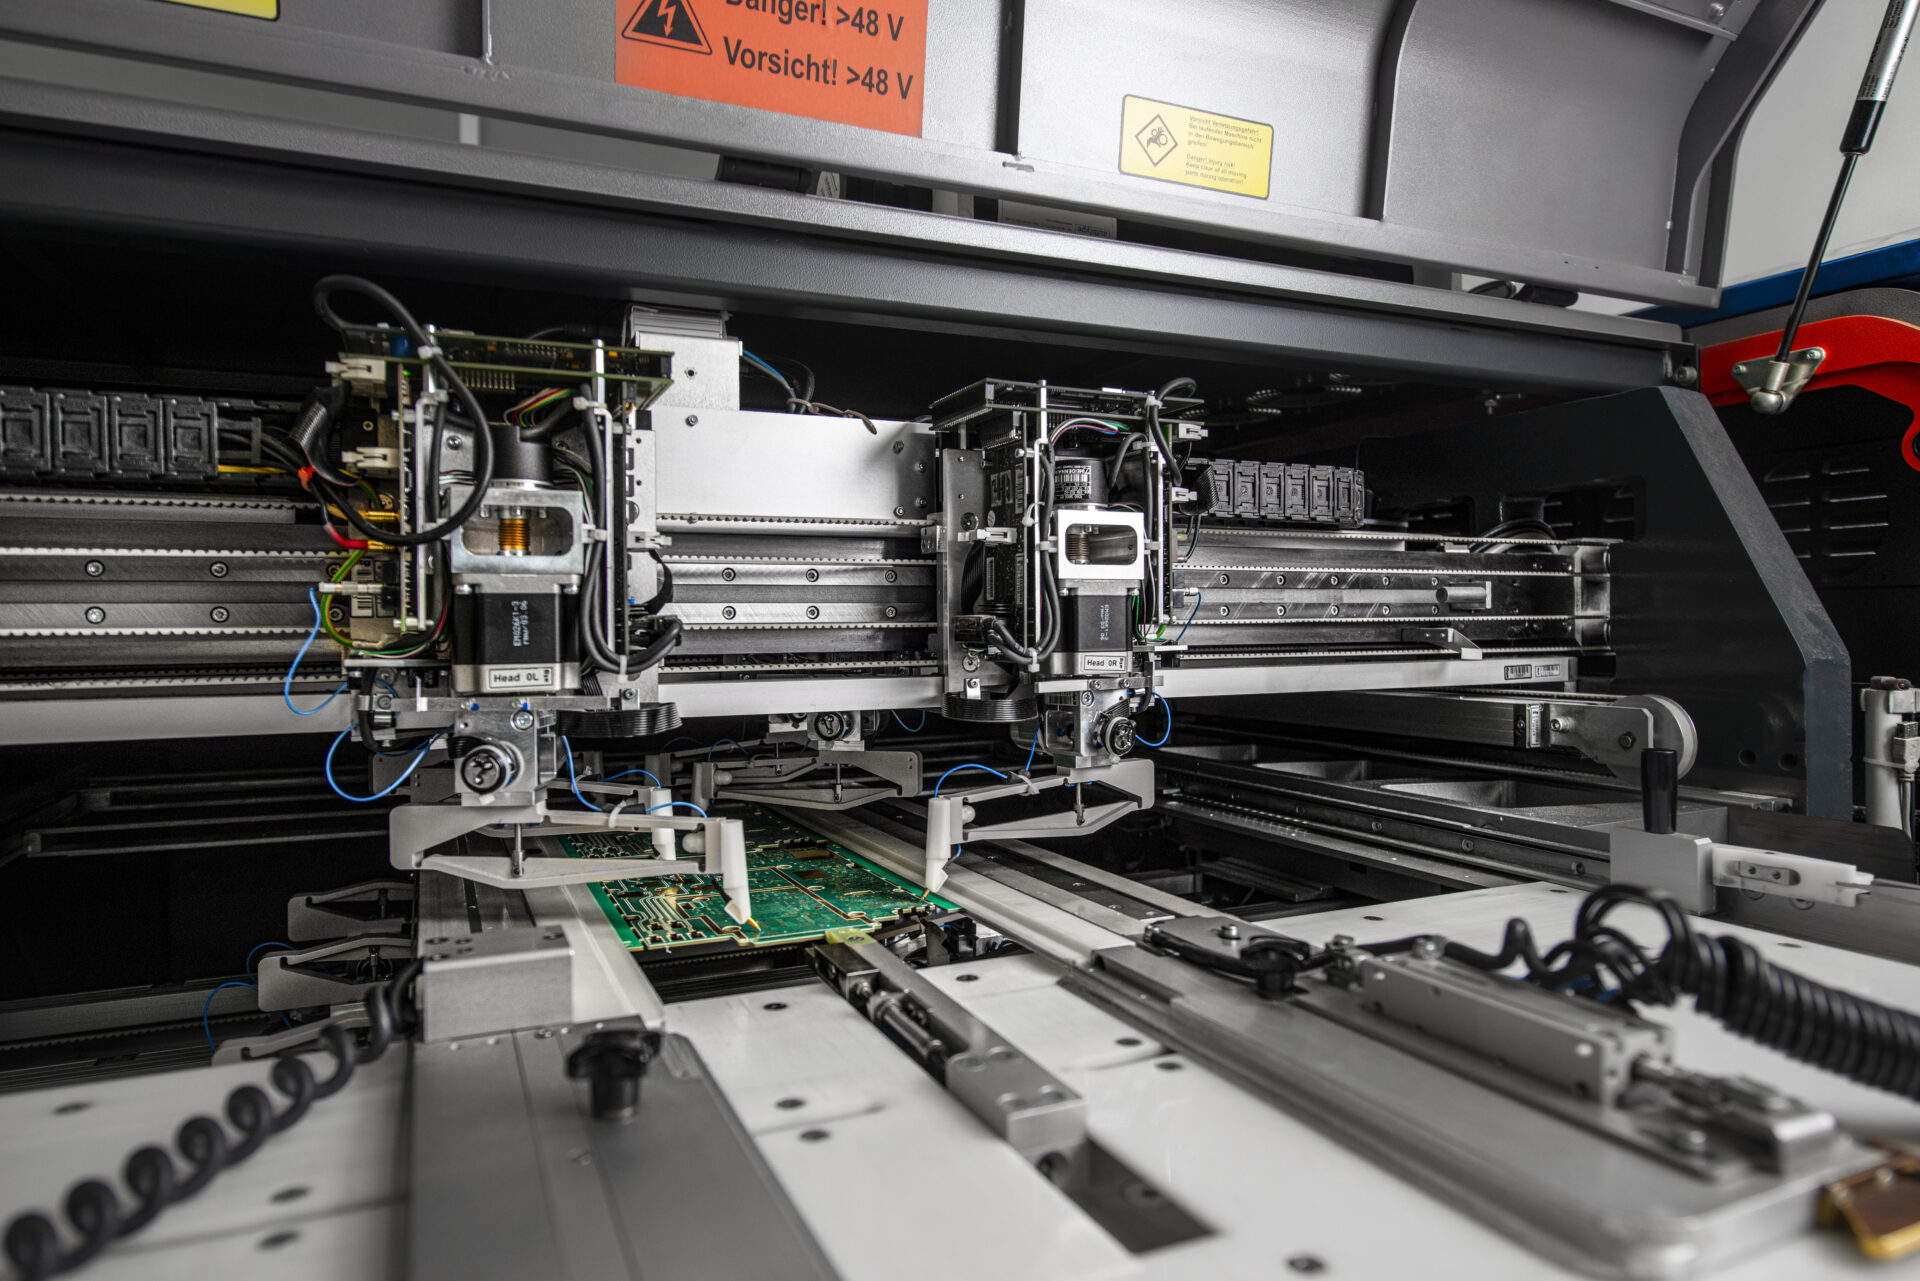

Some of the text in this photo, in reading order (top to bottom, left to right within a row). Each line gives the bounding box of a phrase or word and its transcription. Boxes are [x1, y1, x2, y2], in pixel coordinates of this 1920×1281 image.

[836, 6, 878, 36] >48
[887, 13, 904, 41] V
[723, 36, 914, 100] Vorsicht! >48 V
[1224, 130, 1248, 140] Maschine
[494, 674, 520, 682] Head
